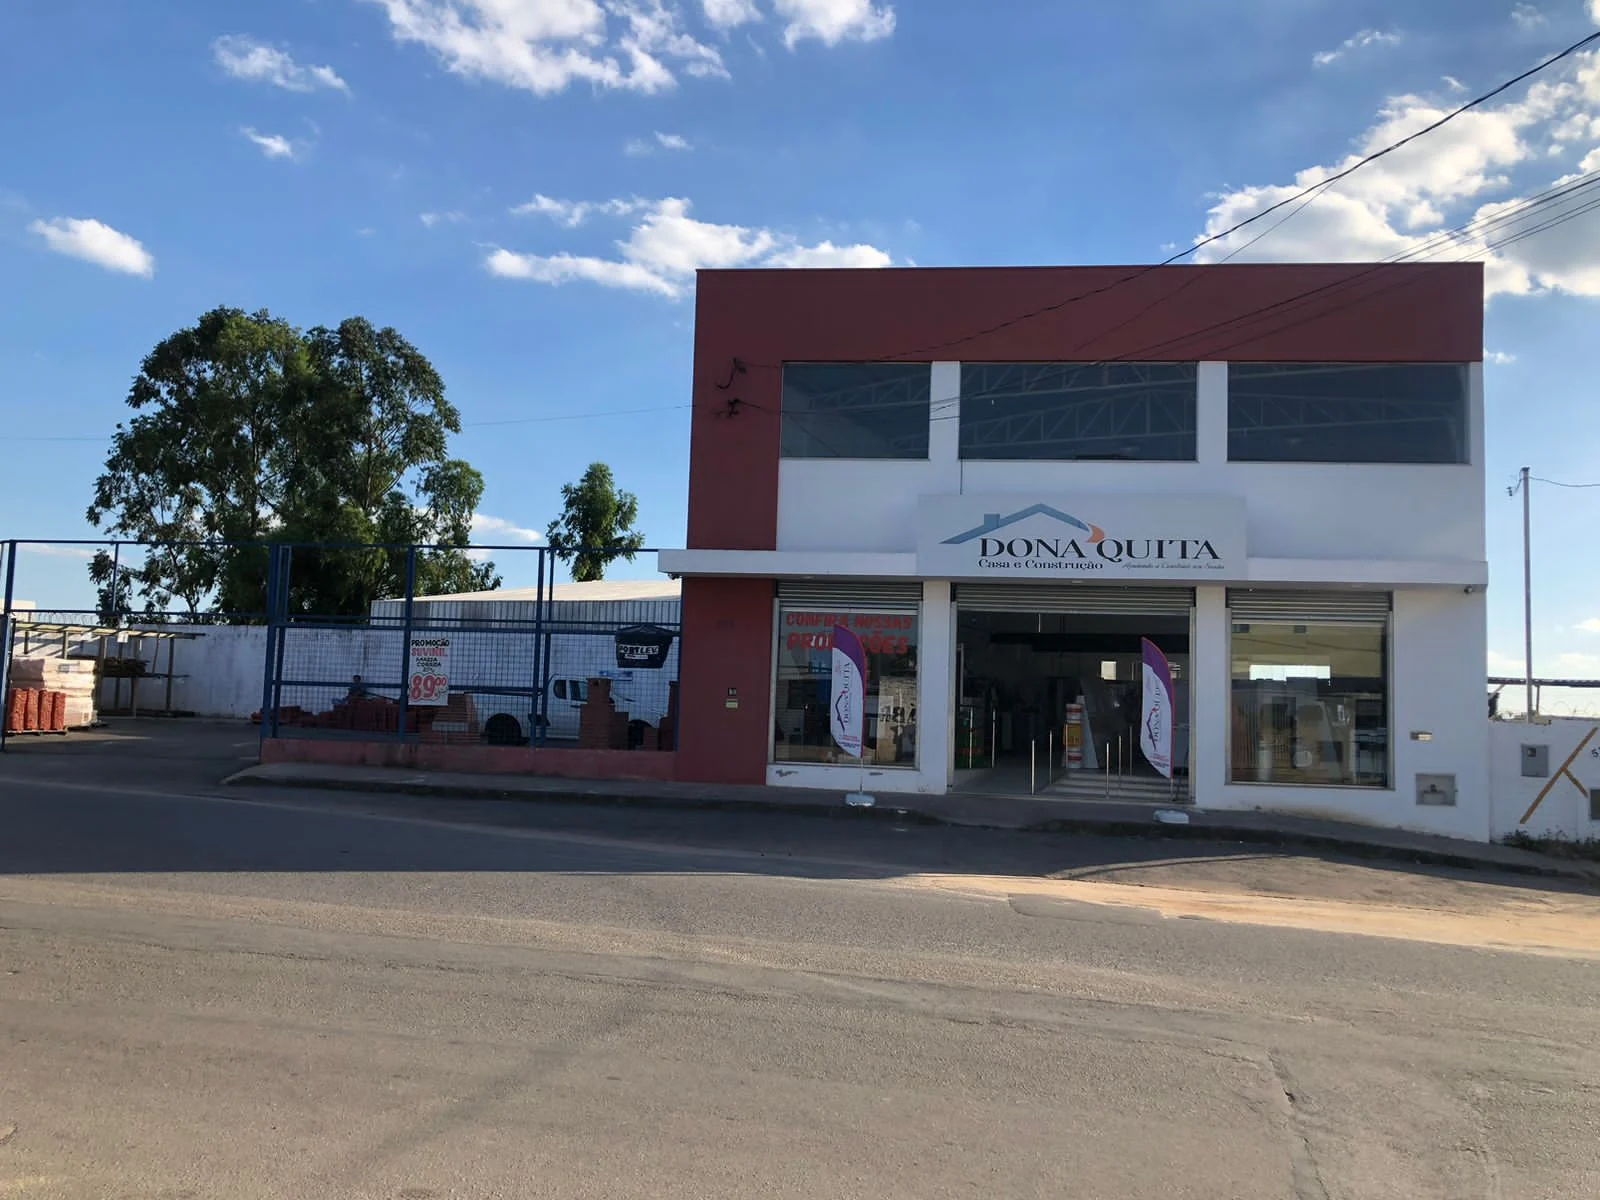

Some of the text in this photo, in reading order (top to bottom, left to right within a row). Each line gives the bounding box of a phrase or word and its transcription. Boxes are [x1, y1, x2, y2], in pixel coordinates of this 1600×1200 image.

[979, 538, 1223, 563] DONA QUITA
[978, 559, 1010, 569] Casa
[1025, 559, 1104, 571] Construção
[786, 613, 912, 630] CONFIRA NOSSAS
[411, 638, 449, 649] PROMOÇÃO
